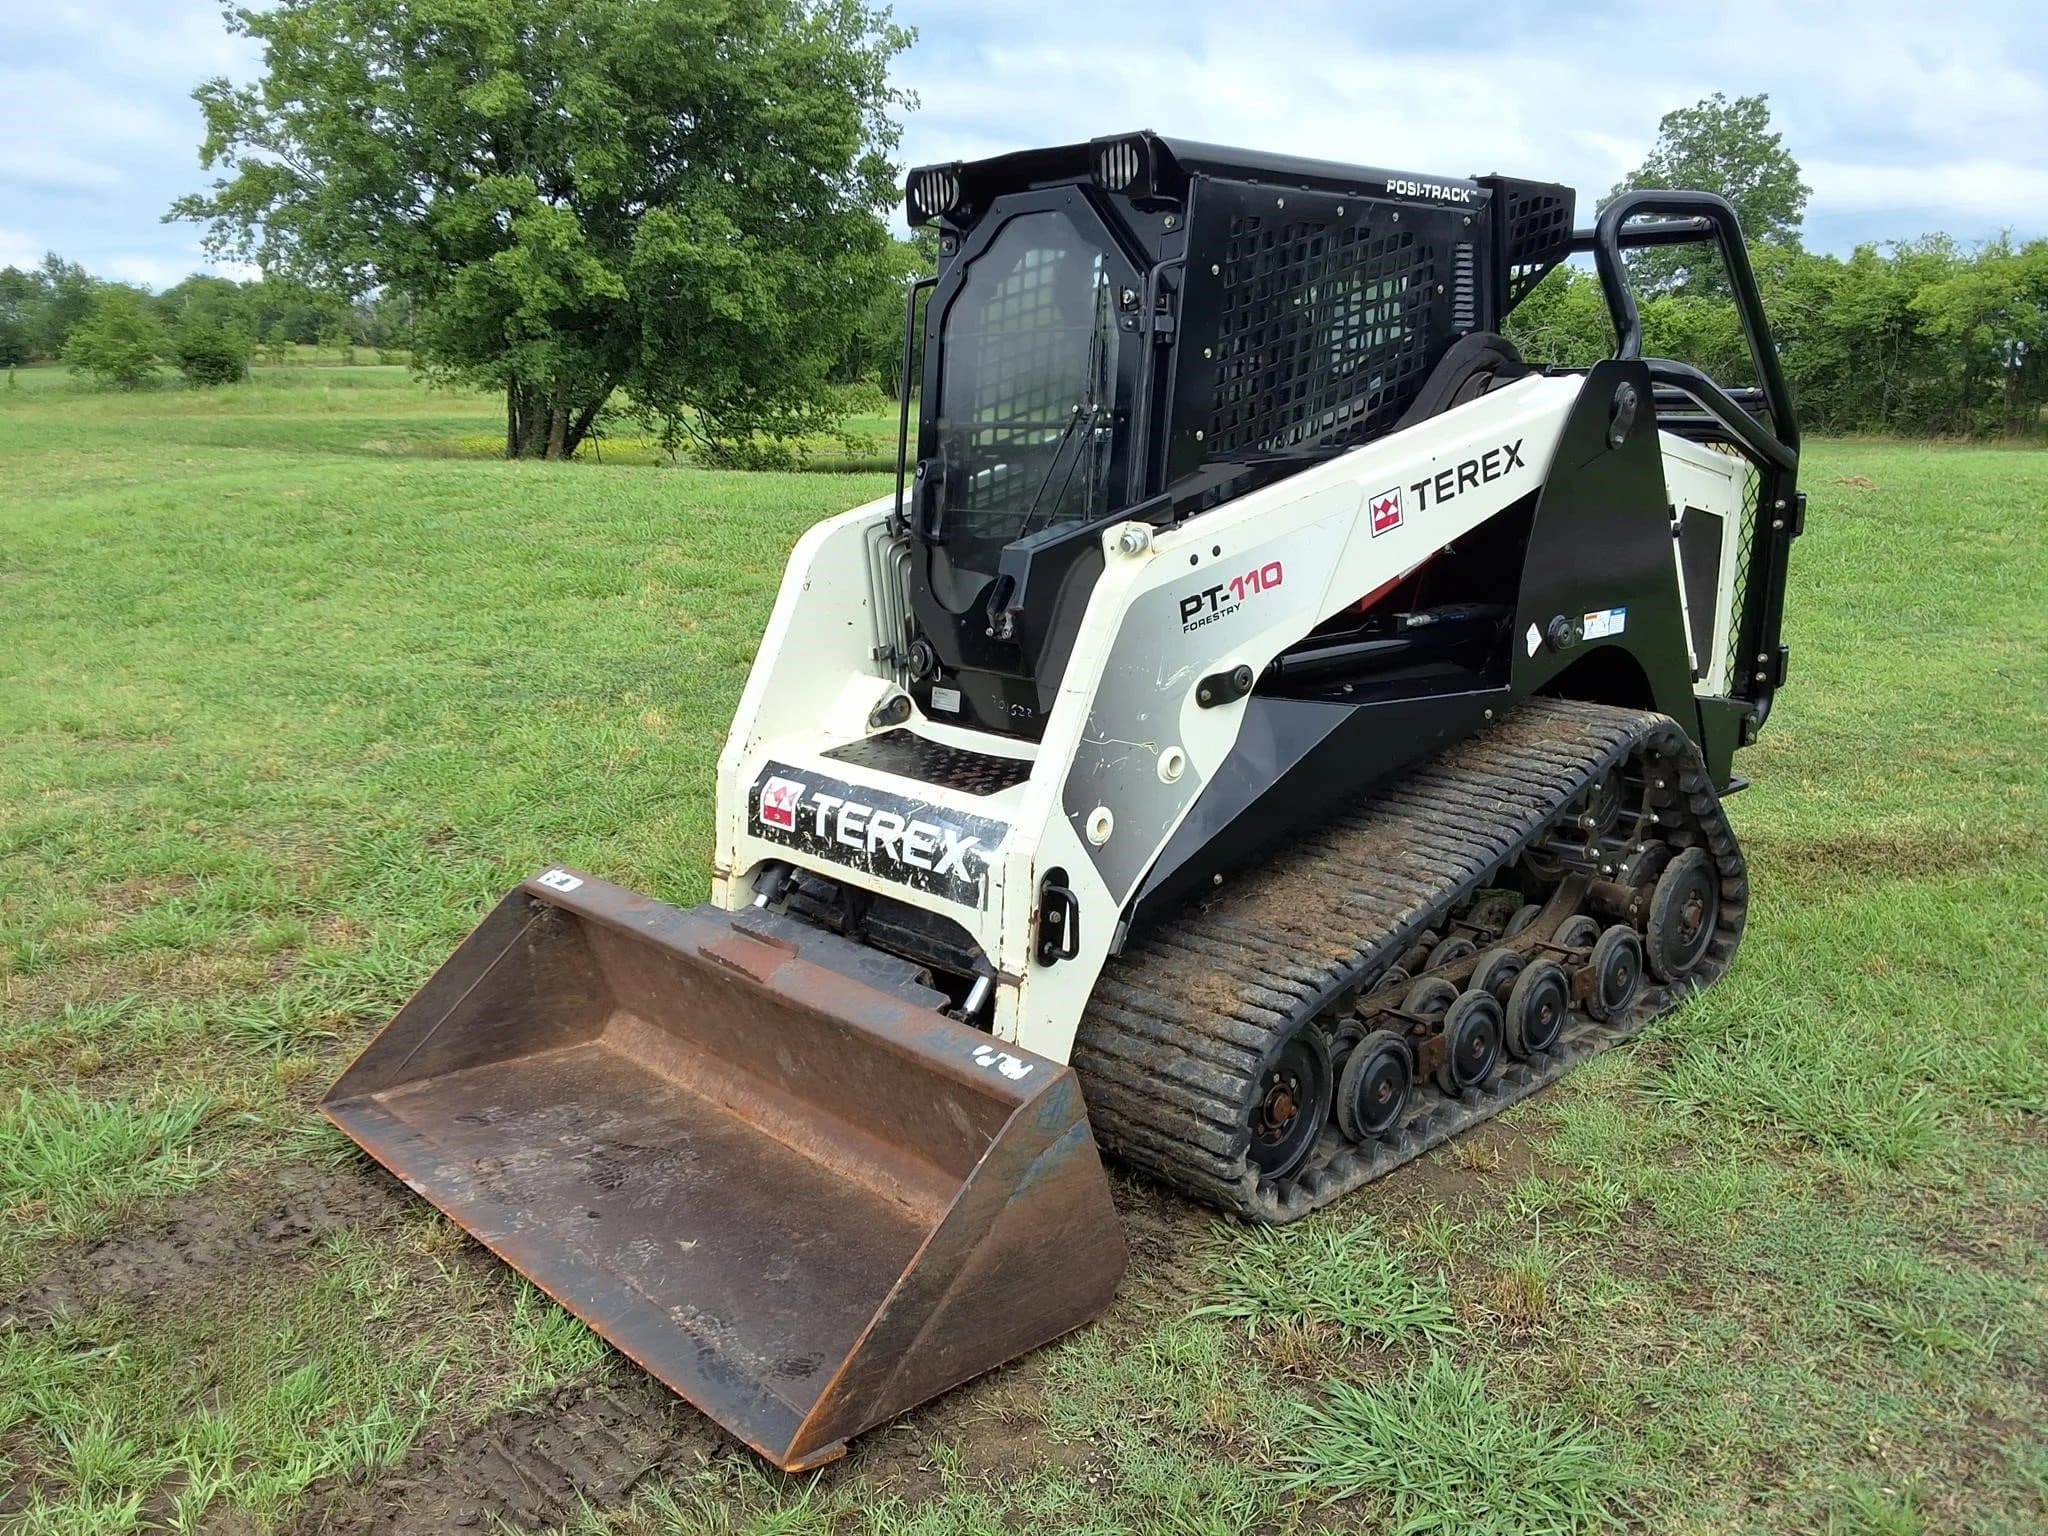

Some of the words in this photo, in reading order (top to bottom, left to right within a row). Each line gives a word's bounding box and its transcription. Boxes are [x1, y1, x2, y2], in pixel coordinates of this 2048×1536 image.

[1410, 438, 1525, 512] TEREX
[1179, 561, 1283, 625] PT-110
[1183, 602, 1241, 634] FORESTRY
[811, 792, 981, 883] TEREX
